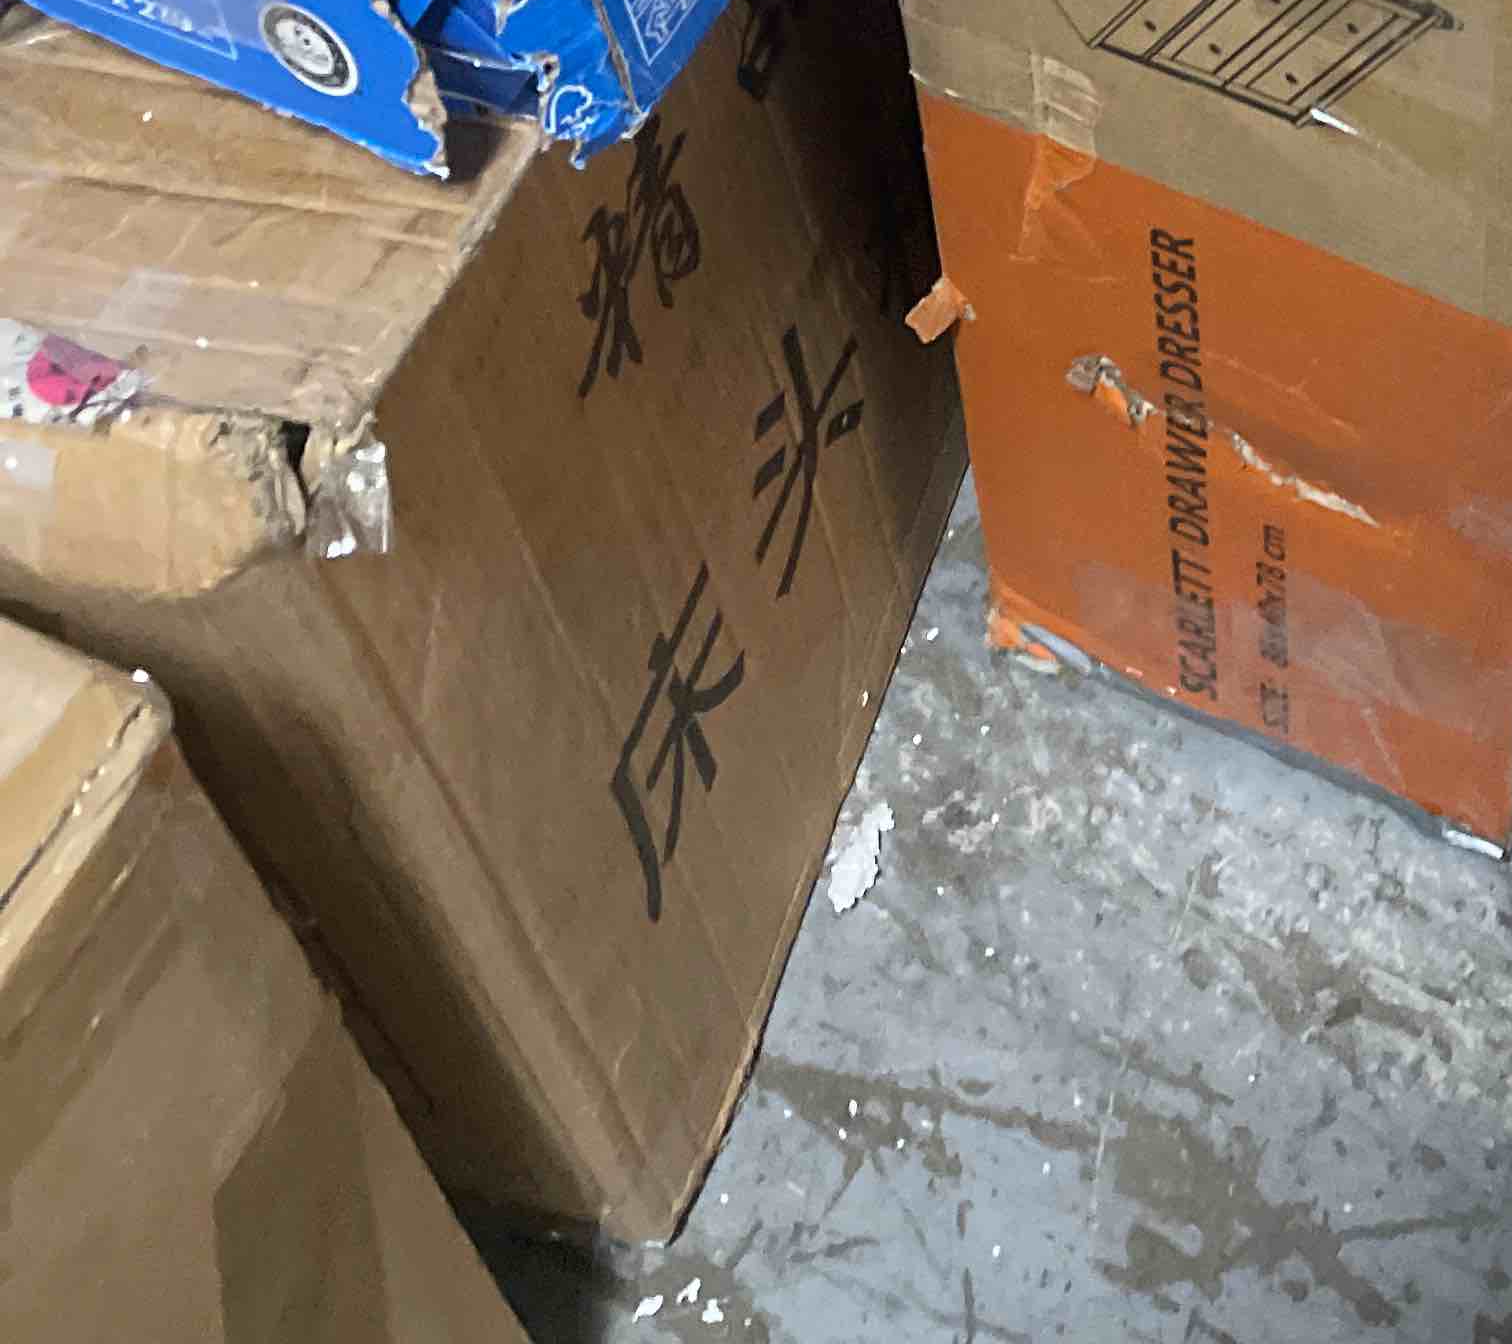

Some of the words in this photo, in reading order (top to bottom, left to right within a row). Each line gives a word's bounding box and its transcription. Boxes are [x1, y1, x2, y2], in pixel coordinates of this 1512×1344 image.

[1151, 227, 1204, 393] DRESSER
[1164, 392, 1210, 546] DRAWER
[1171, 549, 1218, 700] SCARLETT
